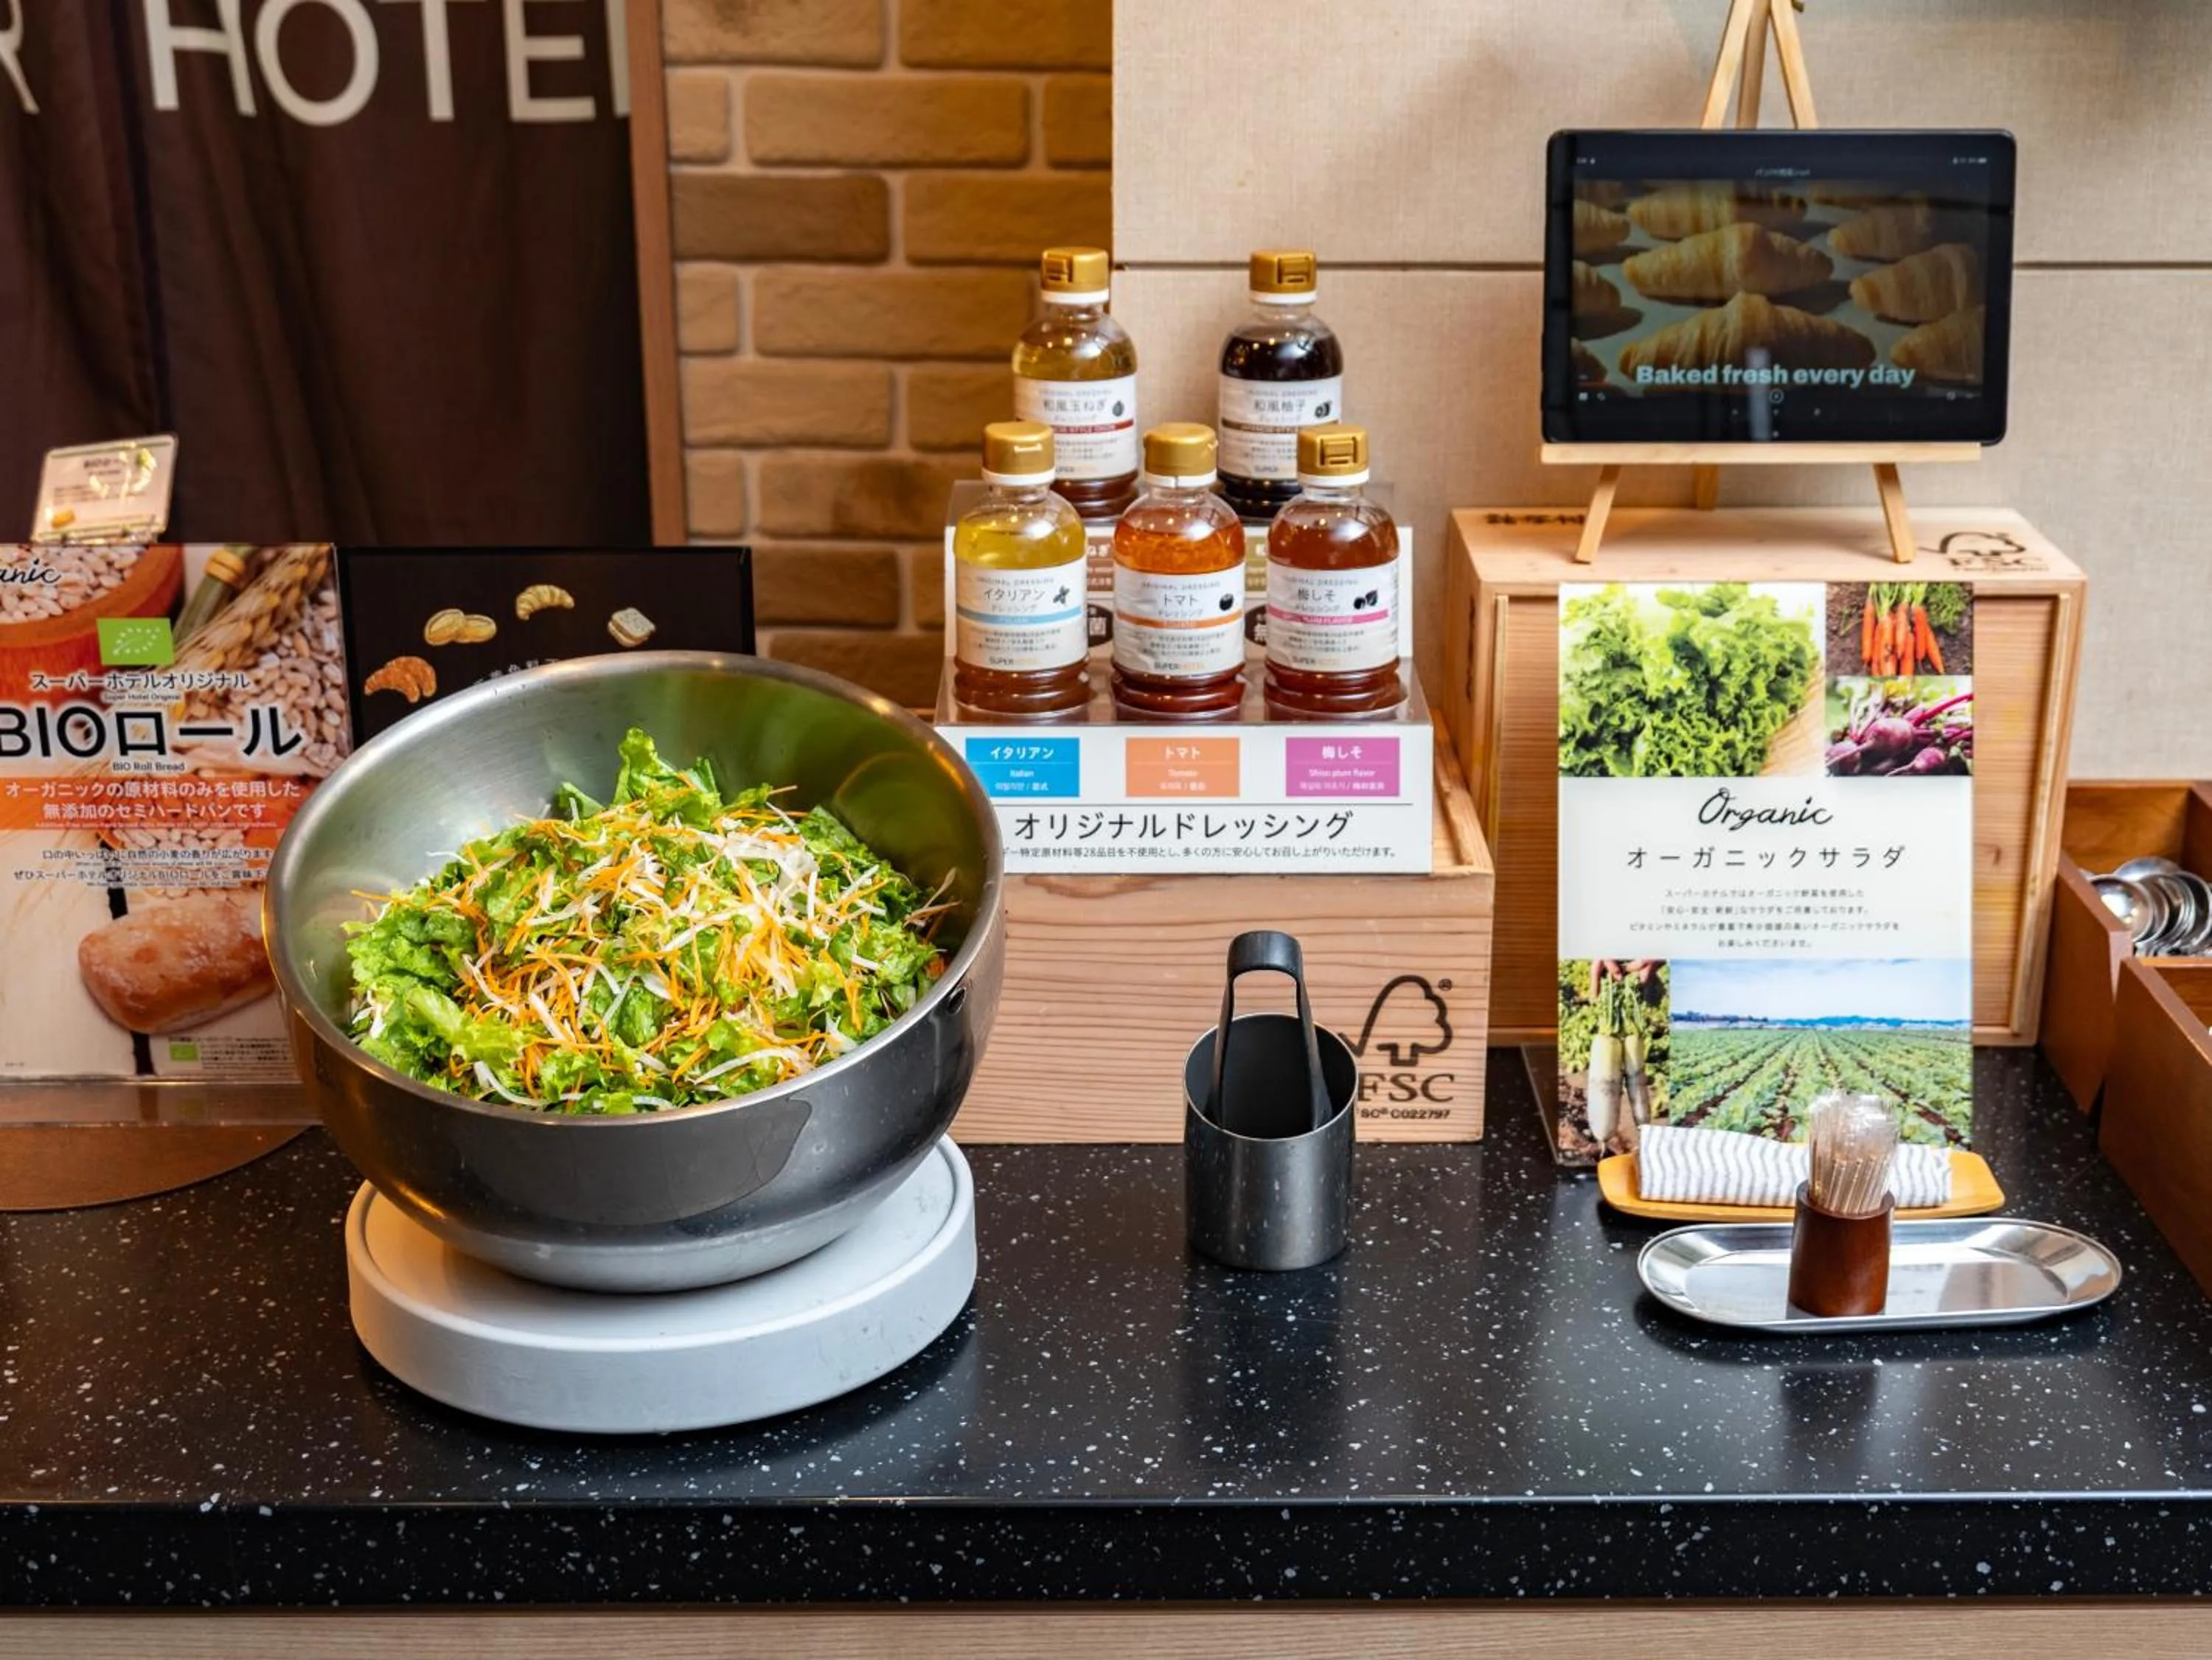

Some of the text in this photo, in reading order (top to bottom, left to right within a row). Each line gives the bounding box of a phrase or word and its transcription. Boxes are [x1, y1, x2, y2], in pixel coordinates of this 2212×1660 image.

[1636, 365, 1916, 388] Baked fresh every day
[984, 588, 1046, 601] イタリアン
[1164, 593, 1199, 607] トマト
[1298, 588, 1335, 601] 梅しそ
[32, 673, 251, 689] スーパーホテルオリジナル
[0, 705, 303, 758] BIOロール
[990, 747, 1054, 760] イタリアン
[1165, 745, 1201, 759] トマト
[1322, 745, 1363, 759] 梅しそ
[112, 761, 185, 771] BIO Roll Bread
[5, 781, 300, 798] オーガニックの原材料のみを使用した
[44, 803, 267, 819] 無添加のセミハードパンです
[1698, 787, 1834, 831] Organic
[1015, 810, 1354, 840] オリジナルドレッシング
[1627, 846, 1905, 869] オーガニックサラダ
[1358, 1073, 1455, 1103] FSC
[1391, 1108, 1451, 1120] C022797
